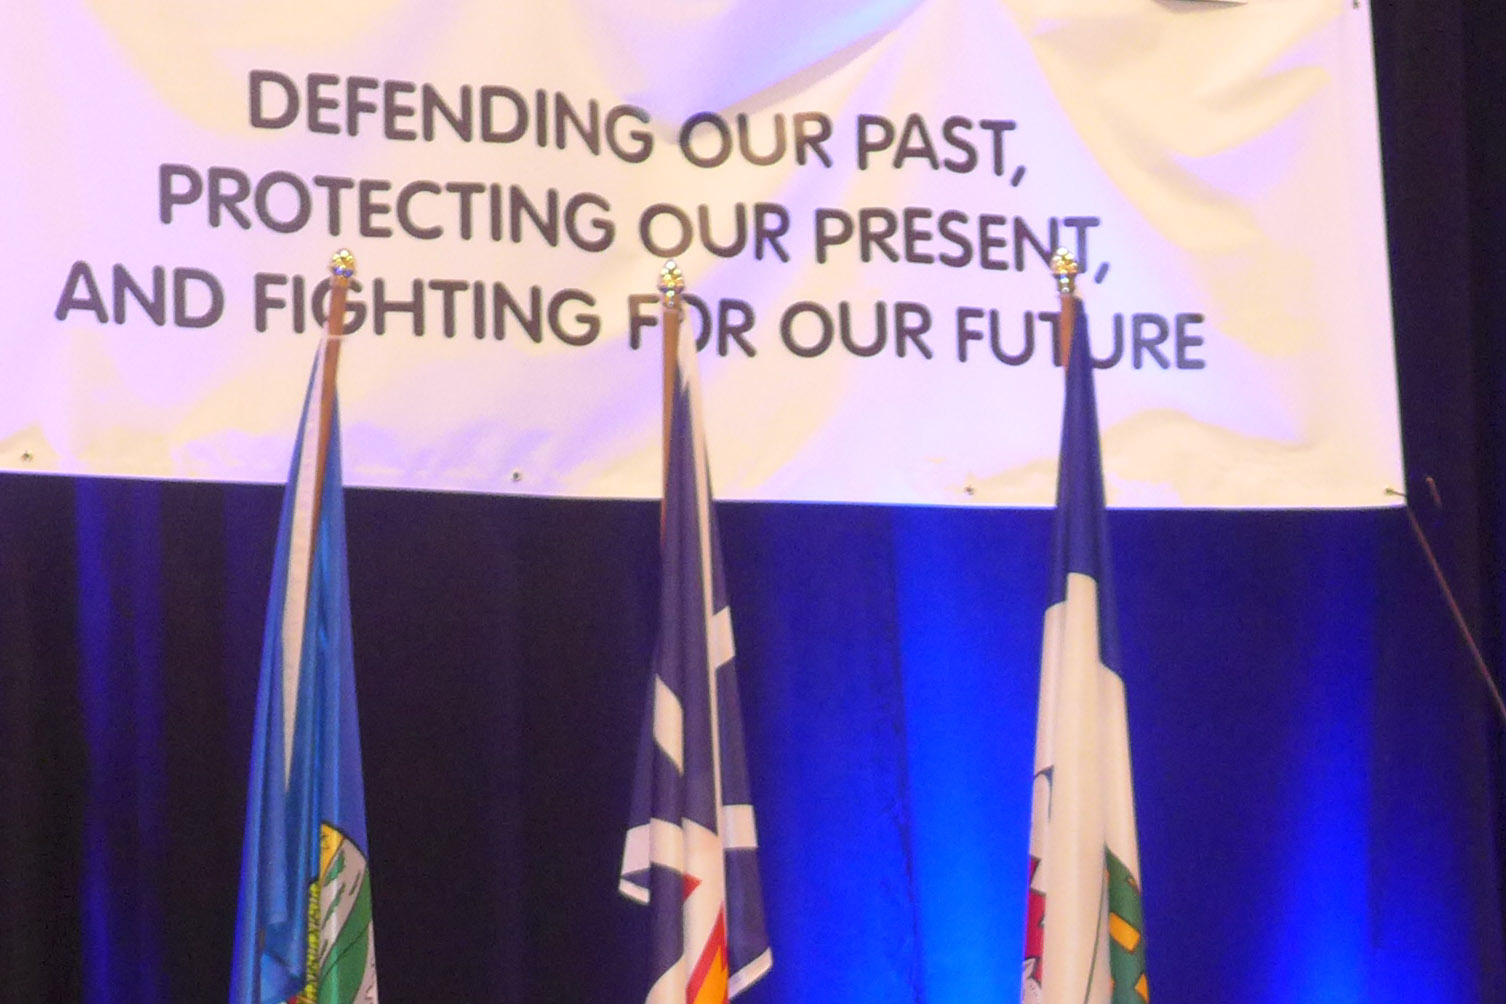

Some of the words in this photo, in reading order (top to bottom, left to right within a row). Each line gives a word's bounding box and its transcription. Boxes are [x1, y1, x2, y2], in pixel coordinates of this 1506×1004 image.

[248, 68, 655, 164] DEFENDING
[677, 110, 833, 168] OUR
[856, 112, 1027, 187] PAST,
[158, 163, 617, 253] PROTECTING
[638, 202, 791, 263] OUR
[815, 206, 1110, 285] PRESENT,
[54, 260, 225, 328] AND
[253, 272, 601, 347] FIGHTING
[780, 301, 933, 360] OUR
[957, 306, 1206, 371] FUTURE
